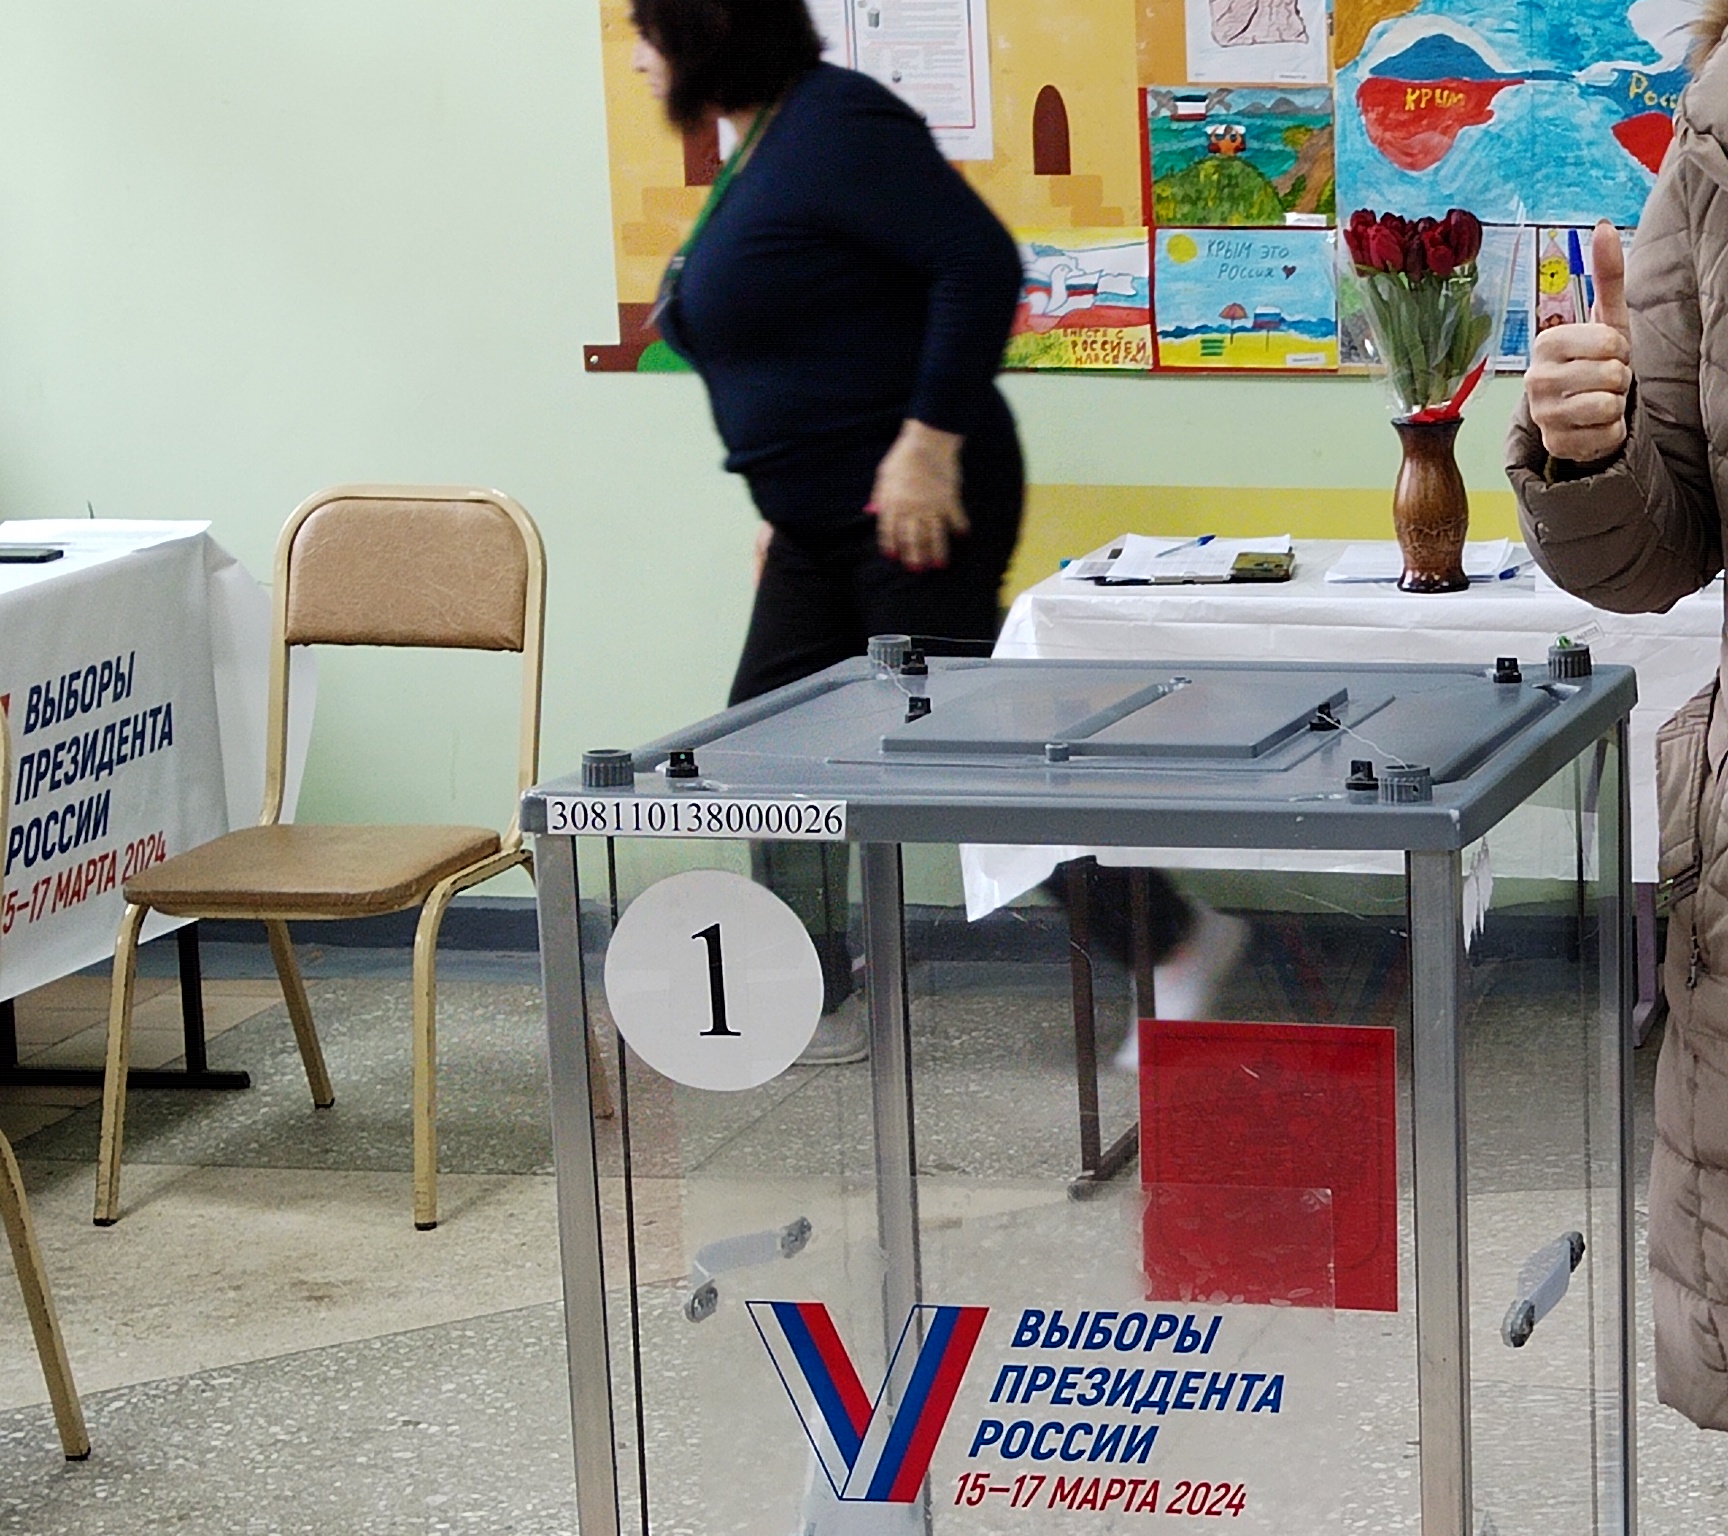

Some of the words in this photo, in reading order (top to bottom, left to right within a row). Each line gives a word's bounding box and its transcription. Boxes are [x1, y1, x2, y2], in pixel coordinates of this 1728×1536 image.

[1206, 239, 1253, 260] КРЫМ
[1070, 337, 1147, 355] РОССИЕЙ
[23, 650, 136, 736] ВЫБОРЫ
[14, 701, 174, 806] ПРЕЗИДЕНТА
[4, 788, 112, 878] РОССИИ
[550, 800, 844, 835] 308110138000026
[50, 849, 118, 914] МАРТА
[690, 923, 742, 1037] 1
[1011, 1308, 1223, 1356] ВЫБОРЫ
[989, 1364, 1286, 1415] ПРЕЗИДЕНТА
[968, 1419, 1160, 1465] РОССИИ
[1046, 1477, 1158, 1515] МАРТА
[1164, 1480, 1247, 1518] 2024
